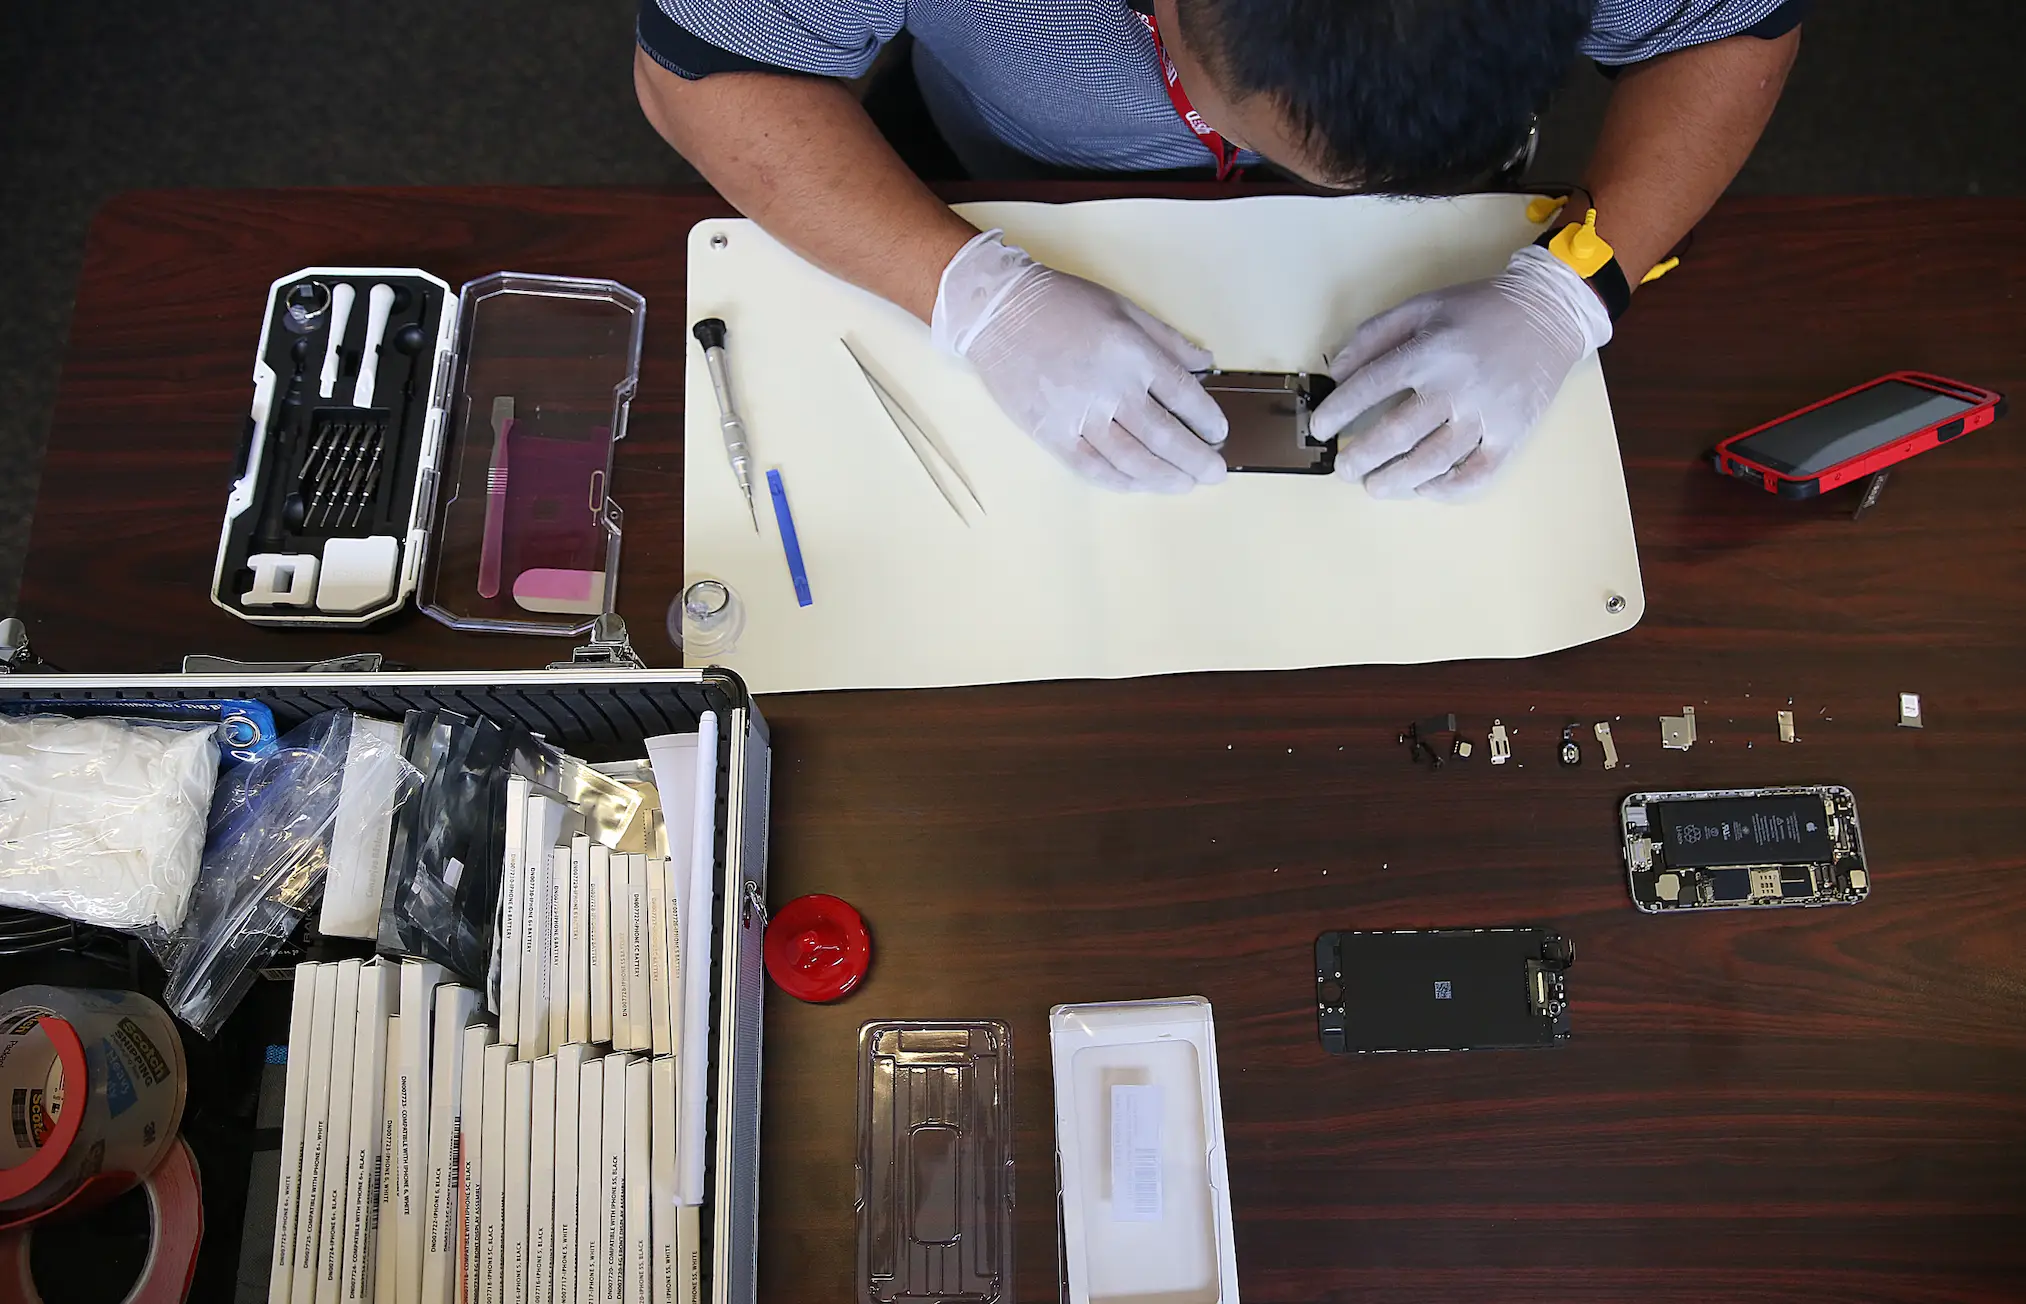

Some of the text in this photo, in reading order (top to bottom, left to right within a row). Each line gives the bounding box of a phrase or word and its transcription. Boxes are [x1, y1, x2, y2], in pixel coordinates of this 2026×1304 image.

[114, 1028, 153, 1088] SHIPPING
[122, 1020, 166, 1081] Scotch
[316, 1121, 324, 1141] WHITE
[313, 1152, 321, 1176] IPHONE
[306, 1193, 316, 1233] COMPATIBLE
[352, 1223, 361, 1263] COMPATIBLE
[608, 1227, 616, 1265] COMPATIBLE
